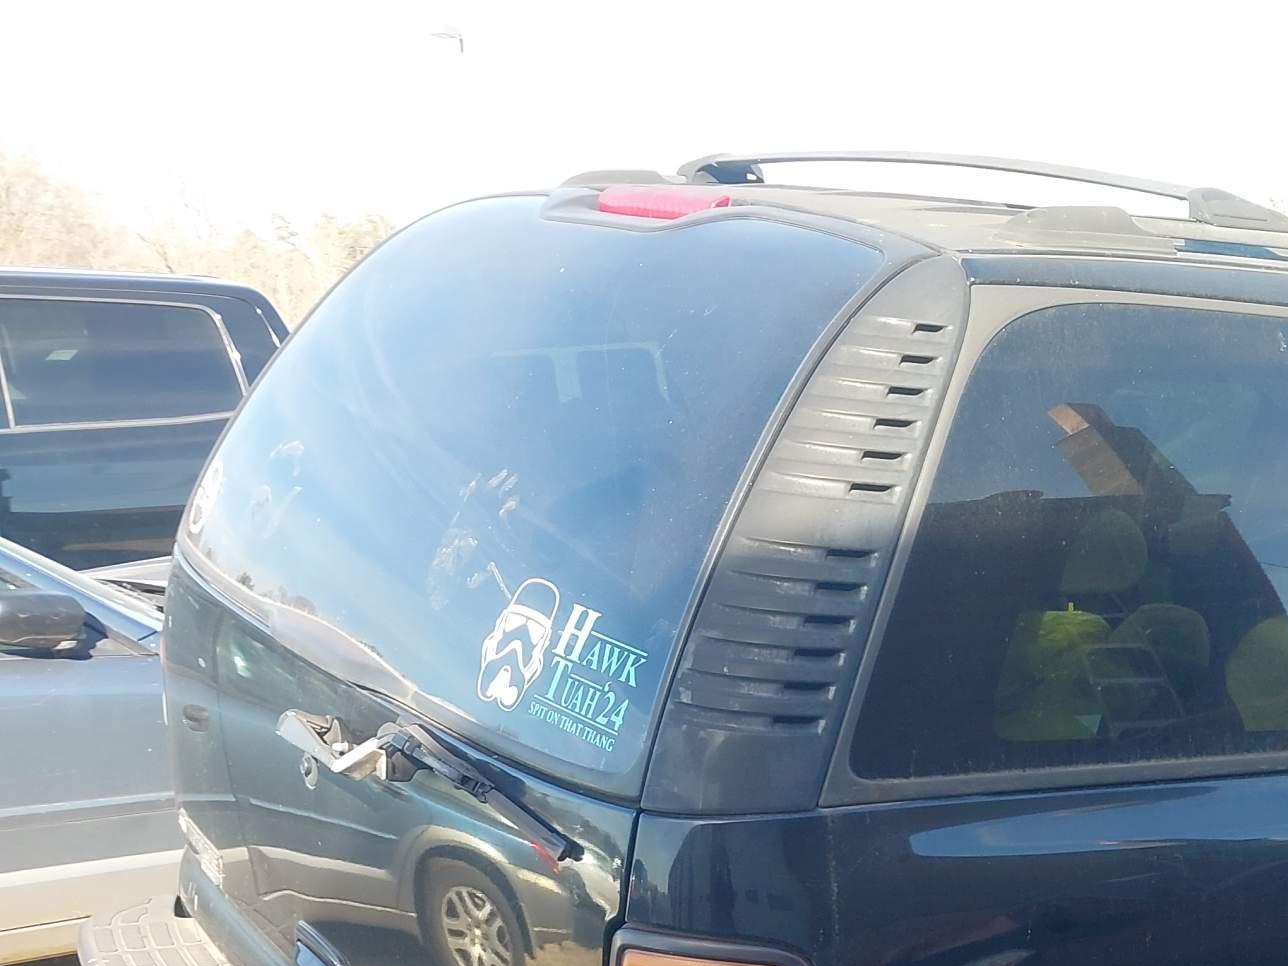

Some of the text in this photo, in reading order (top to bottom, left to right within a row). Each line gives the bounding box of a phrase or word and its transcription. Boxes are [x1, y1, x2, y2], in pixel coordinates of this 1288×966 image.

[527, 701, 616, 753] SPIT ON THAT THANG
